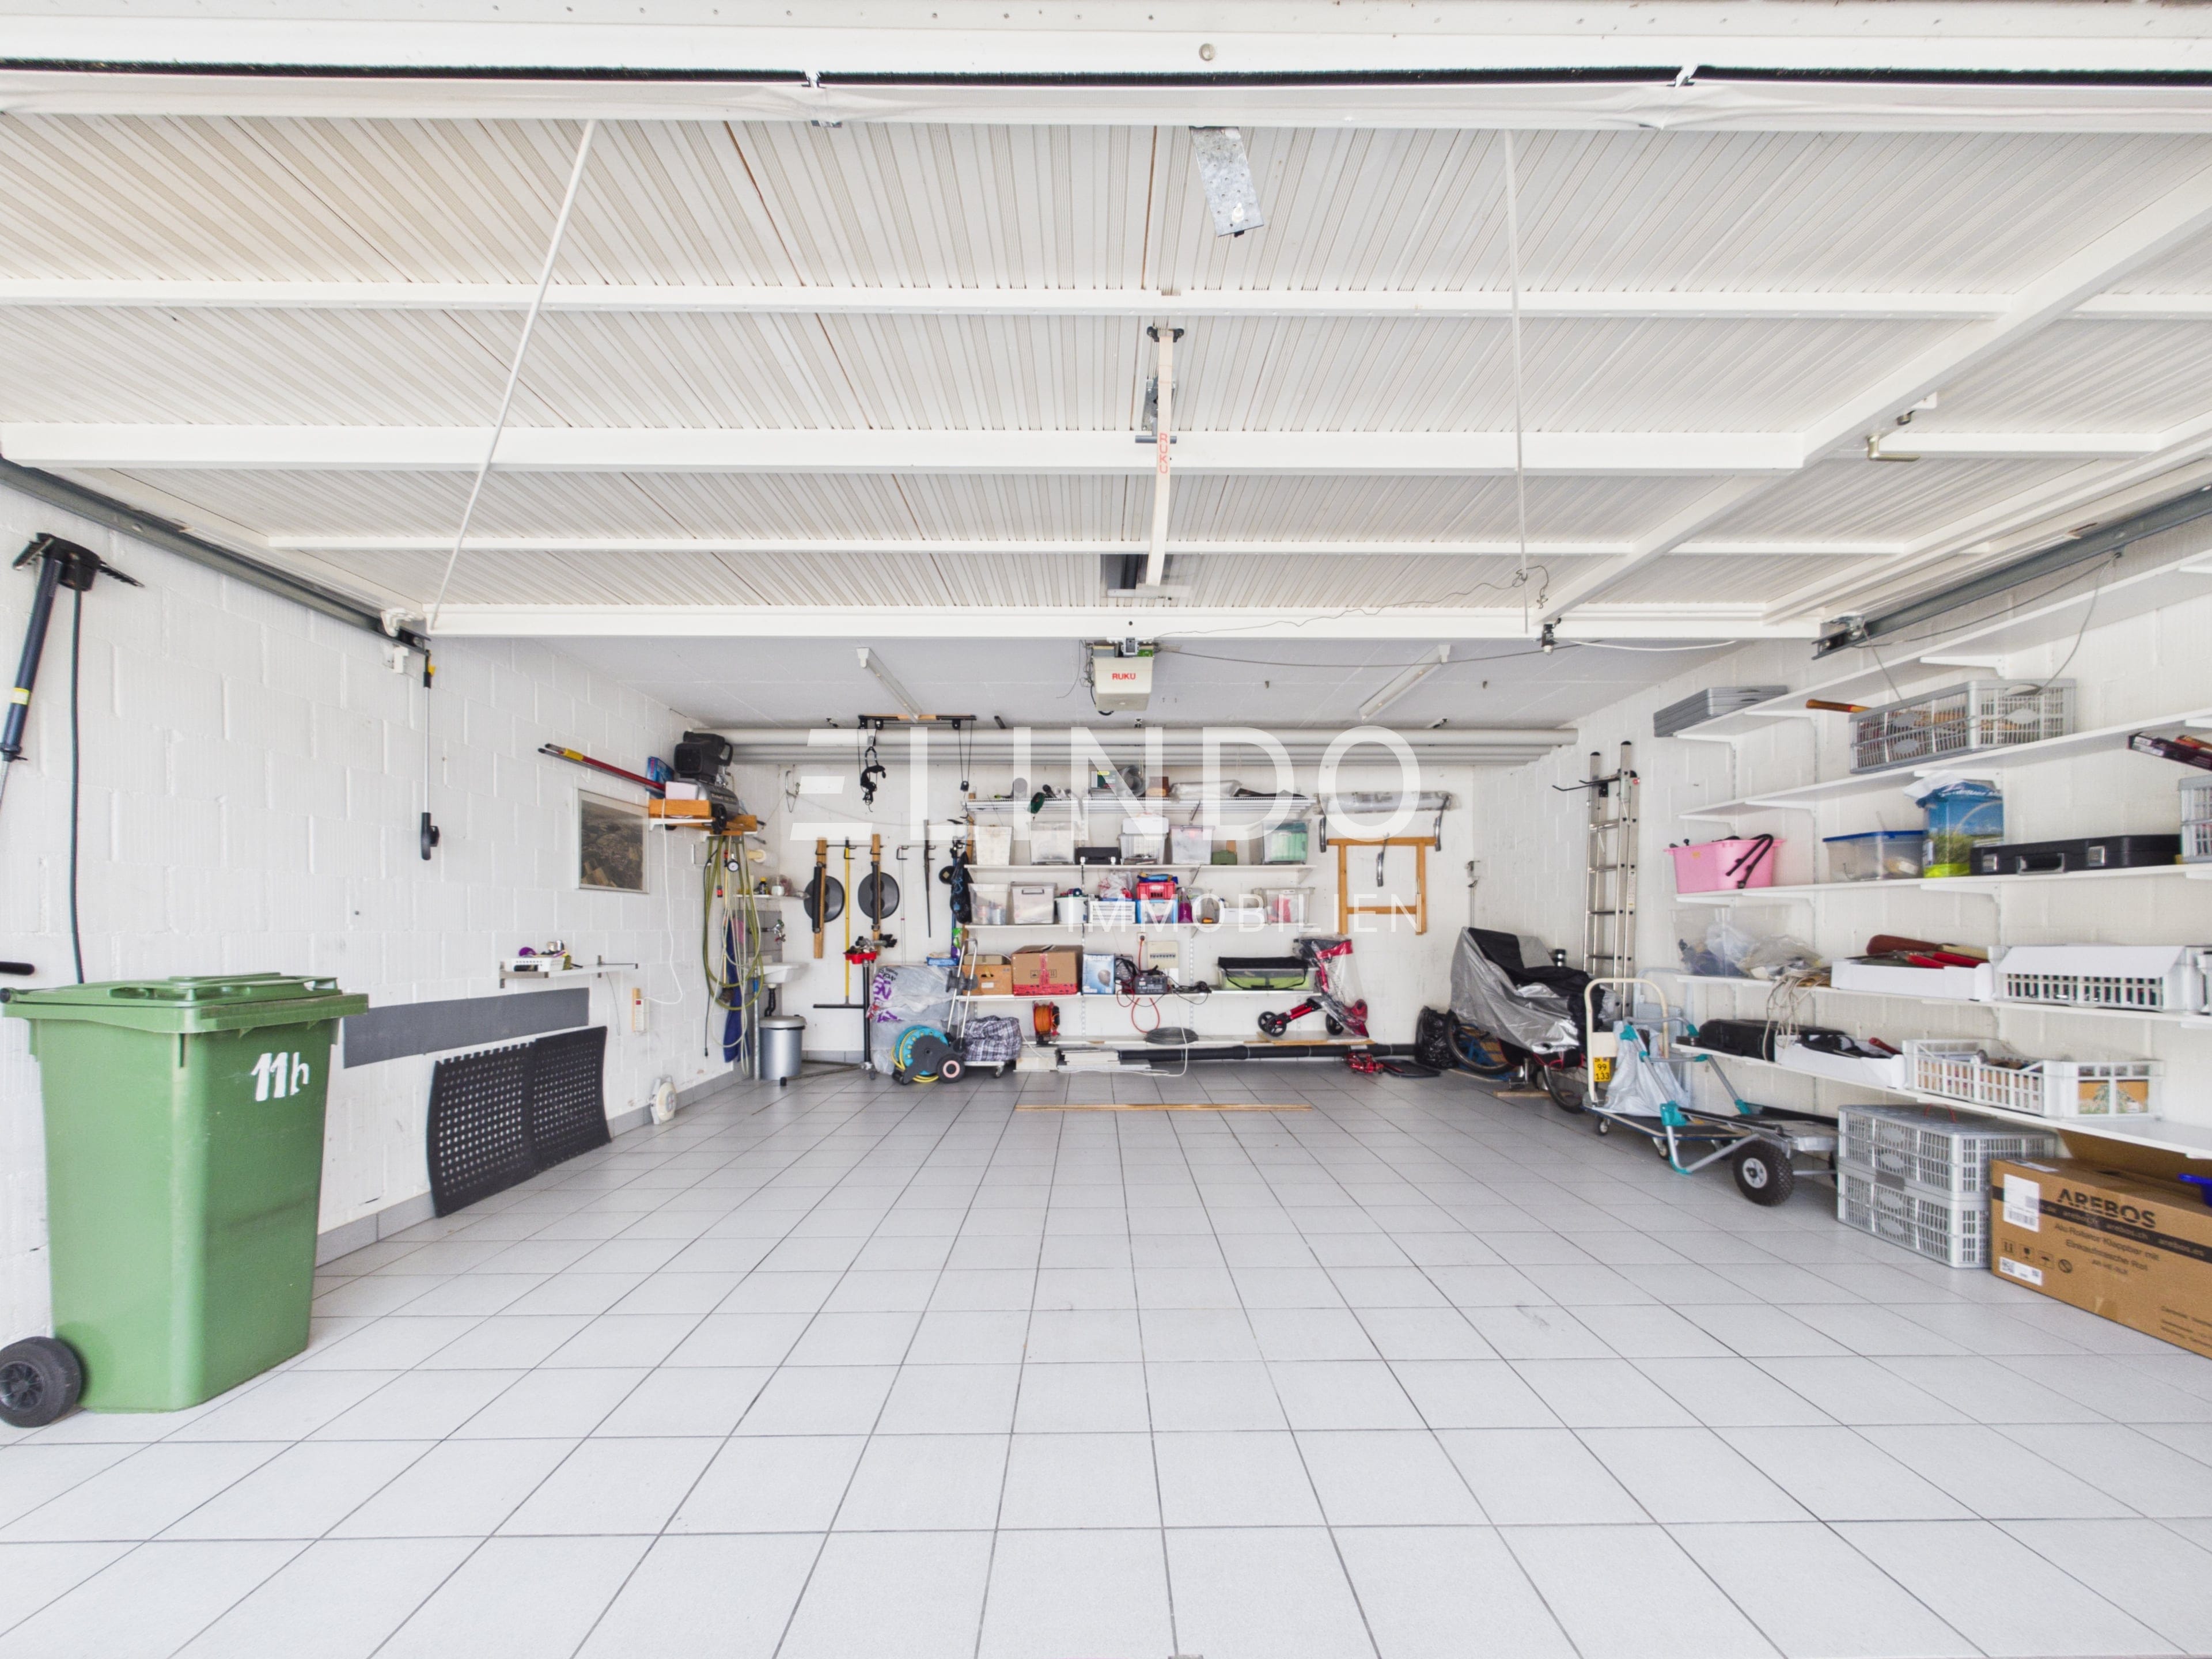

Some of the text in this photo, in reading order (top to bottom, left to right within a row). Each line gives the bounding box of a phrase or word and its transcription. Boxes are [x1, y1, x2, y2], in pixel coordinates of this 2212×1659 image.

[1159, 433, 1168, 474] RUKU
[1112, 672, 1137, 680] RUKU
[2056, 1188, 2156, 1228] AREBOS
